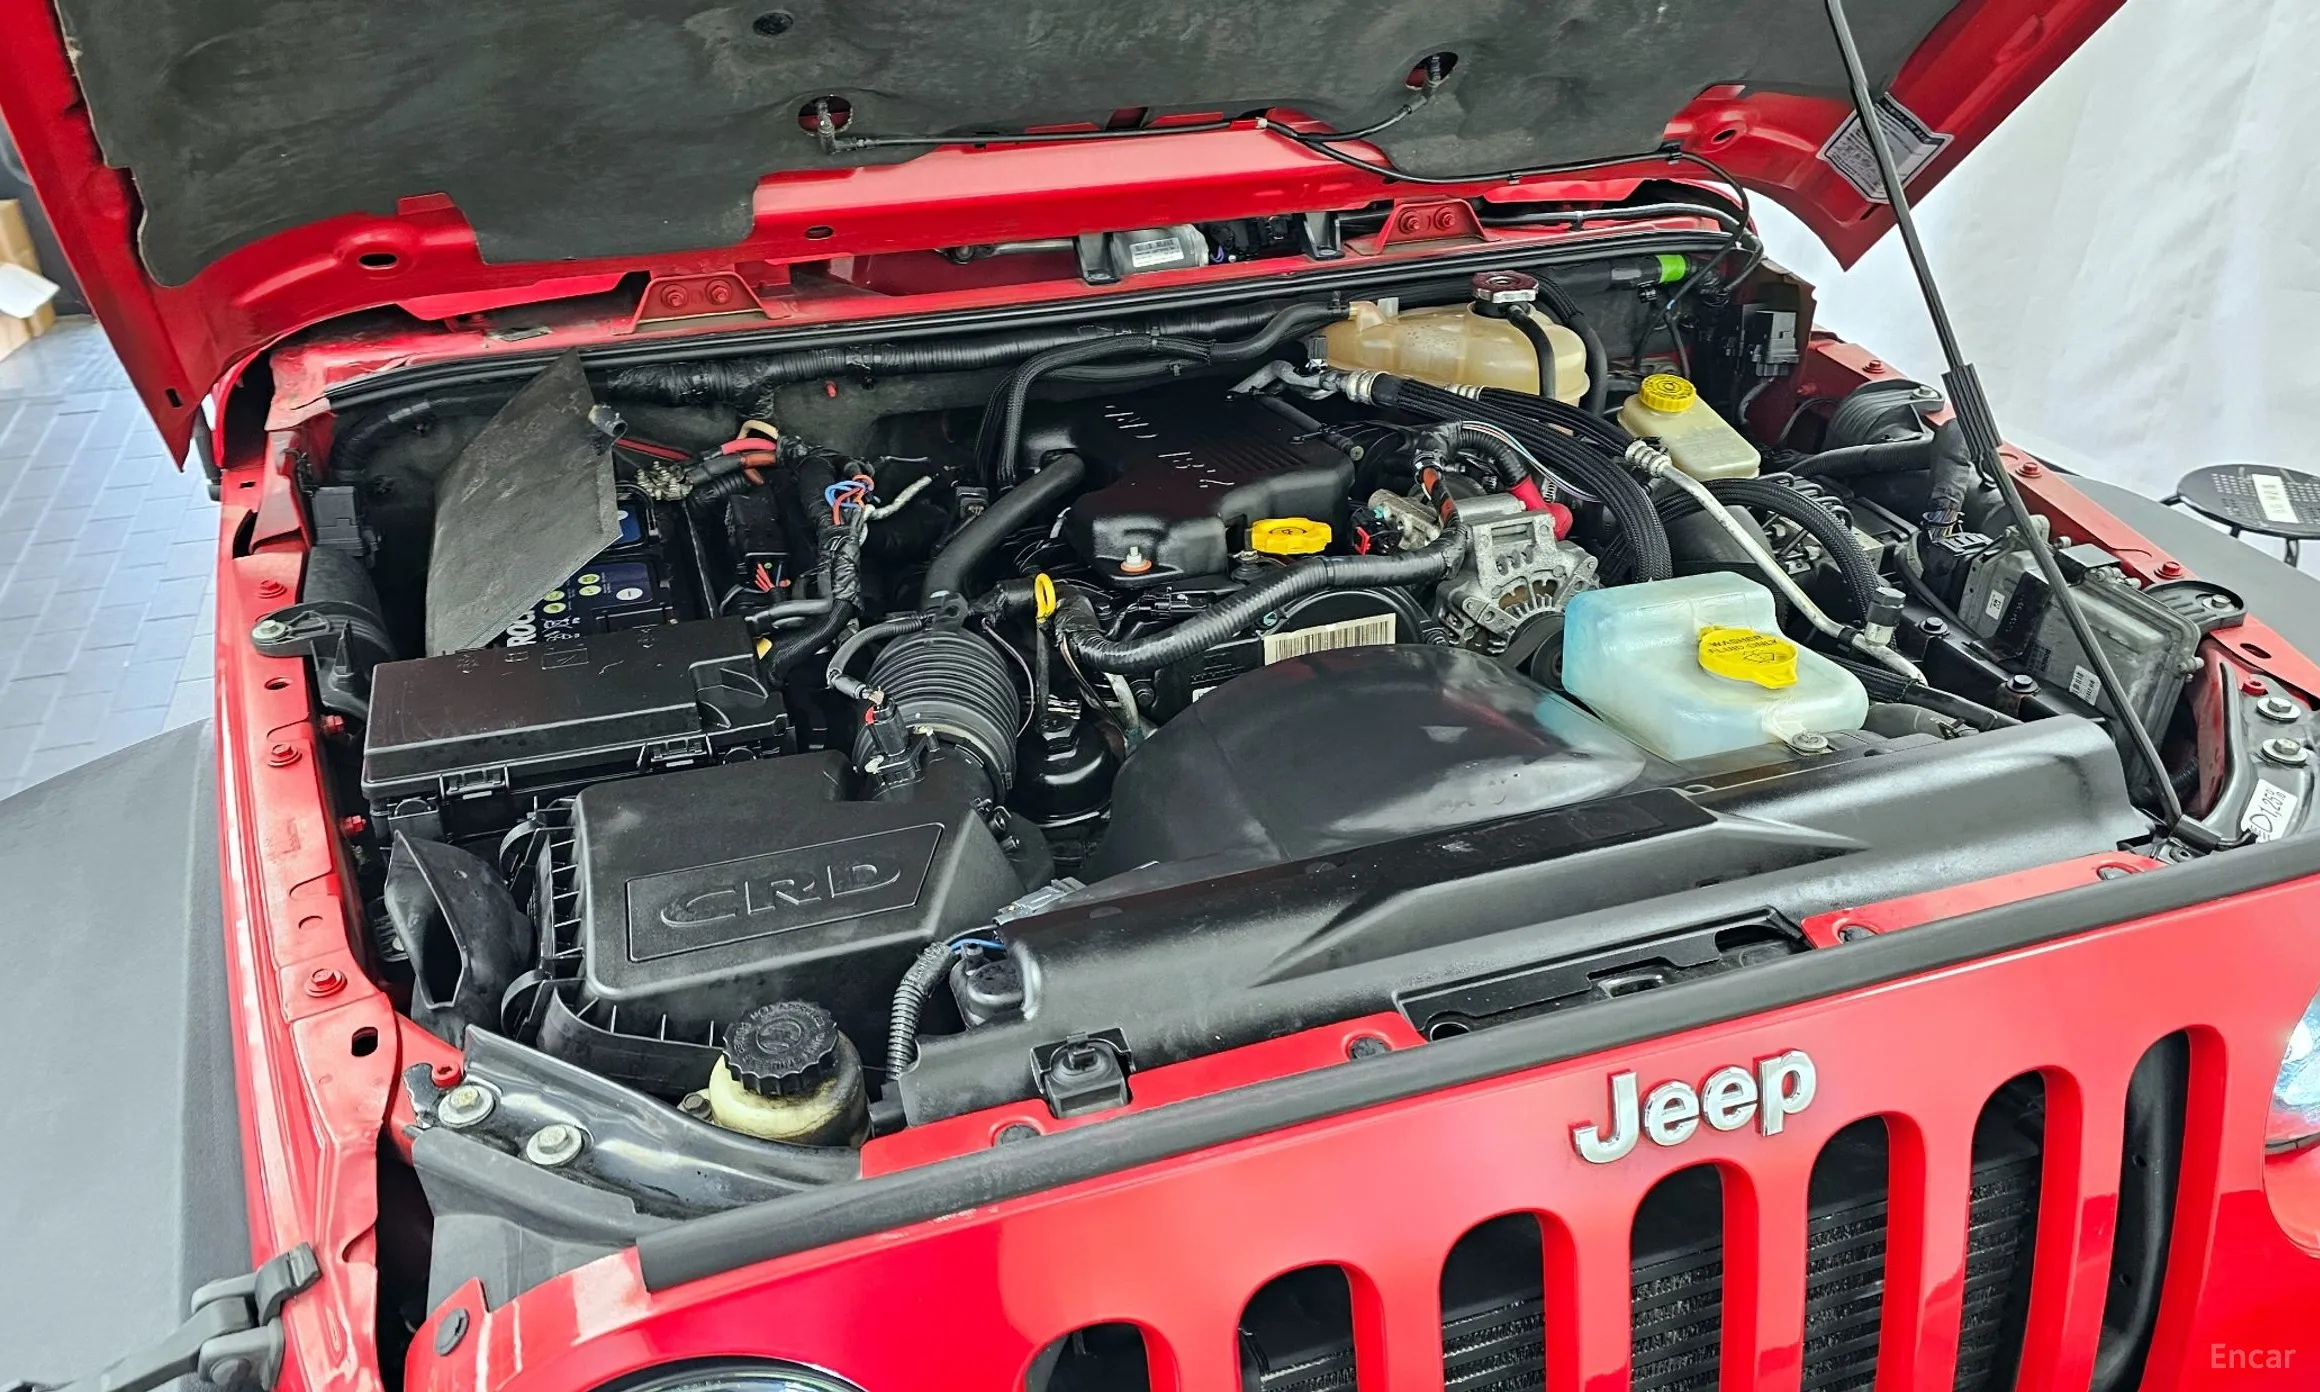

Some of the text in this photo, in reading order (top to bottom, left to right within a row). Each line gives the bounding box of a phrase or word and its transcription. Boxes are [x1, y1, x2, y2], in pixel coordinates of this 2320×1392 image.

[507, 610, 537, 647] ROC
[1708, 635, 1763, 647] WASHER
[1708, 639, 1777, 654] FLUID ONLY
[660, 864, 901, 928] CRD
[1573, 1049, 1817, 1164] Jeep
